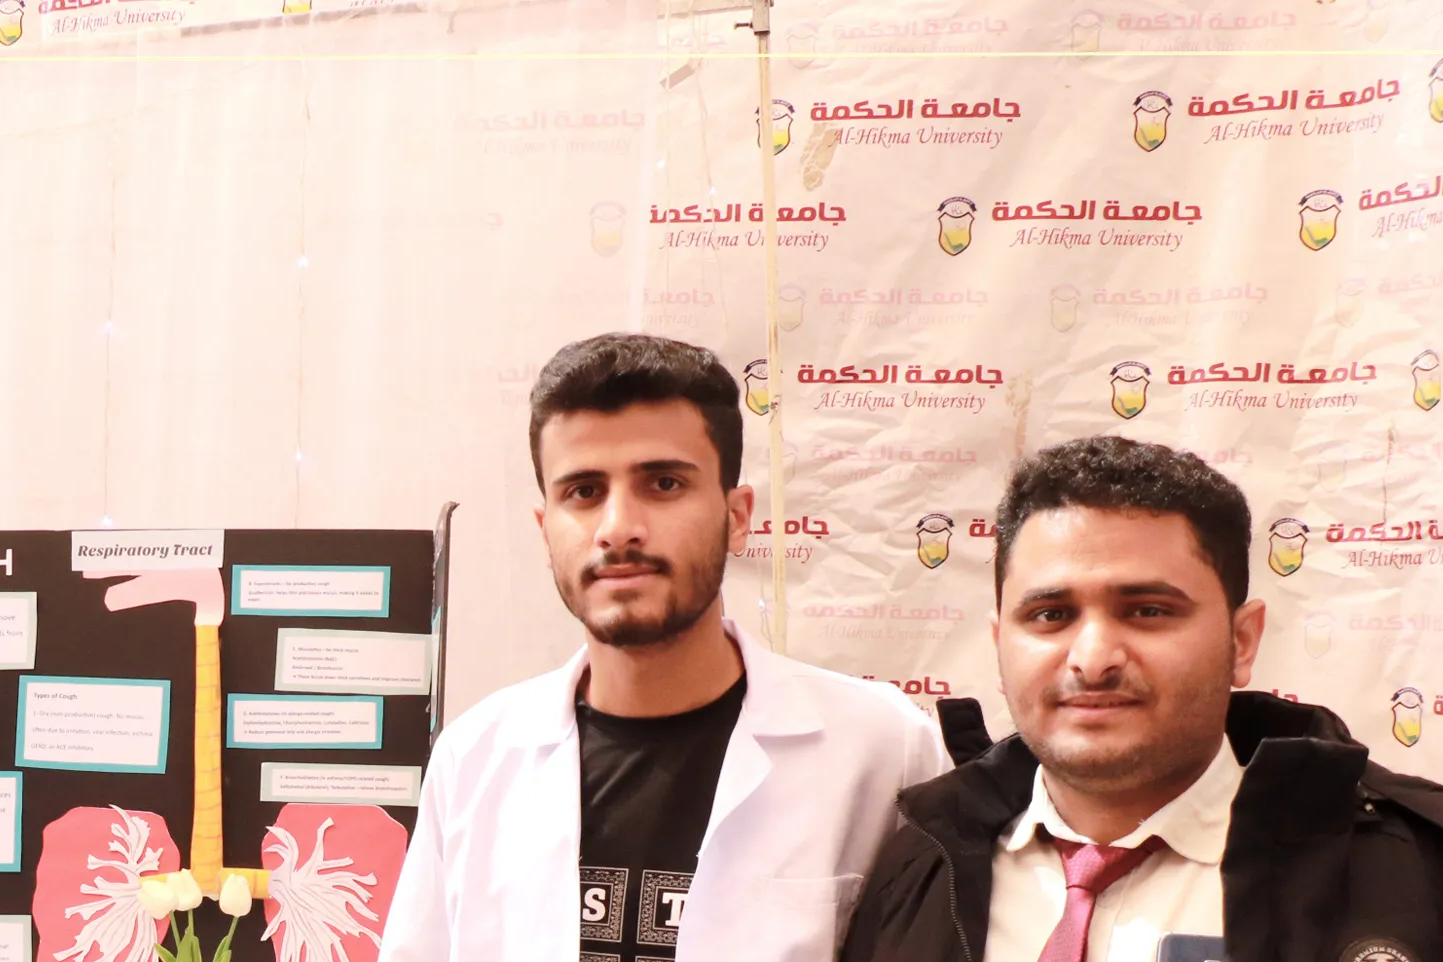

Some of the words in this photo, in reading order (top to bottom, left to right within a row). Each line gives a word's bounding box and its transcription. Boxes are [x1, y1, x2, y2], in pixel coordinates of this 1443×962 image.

[1188, 90, 1298, 117] الحكمة
[1305, 79, 1400, 110] جامعة
[811, 99, 913, 121] الحكمة
[921, 98, 1021, 122] جامعة
[827, 127, 911, 148] Al-Hikma
[916, 127, 1002, 149] University
[1204, 121, 1292, 144] Al-Hikma
[1299, 111, 1385, 138] University
[1359, 176, 1443, 211] لحكمة
[992, 200, 1096, 221] الحكمة
[1103, 200, 1202, 225] جامعة
[661, 231, 738, 251] Al-Hikma
[1009, 227, 1091, 249] Al-Hikma
[1098, 228, 1183, 252] University
[798, 364, 897, 384] الحكمة
[905, 365, 1003, 389] جامعة
[1167, 362, 1271, 385] الحكمة
[1277, 362, 1377, 384] جامعة
[814, 391, 894, 412] Al-Hikma
[902, 391, 985, 414] University
[1185, 390, 1267, 411] Al-Hikma
[1273, 391, 1358, 412] University
[1326, 521, 1423, 543] الحكمة
[78, 544, 169, 559] Respiratory
[173, 544, 213, 556] Tract
[1342, 548, 1423, 570] Al-Hikma
[34, 692, 50, 700] Types
